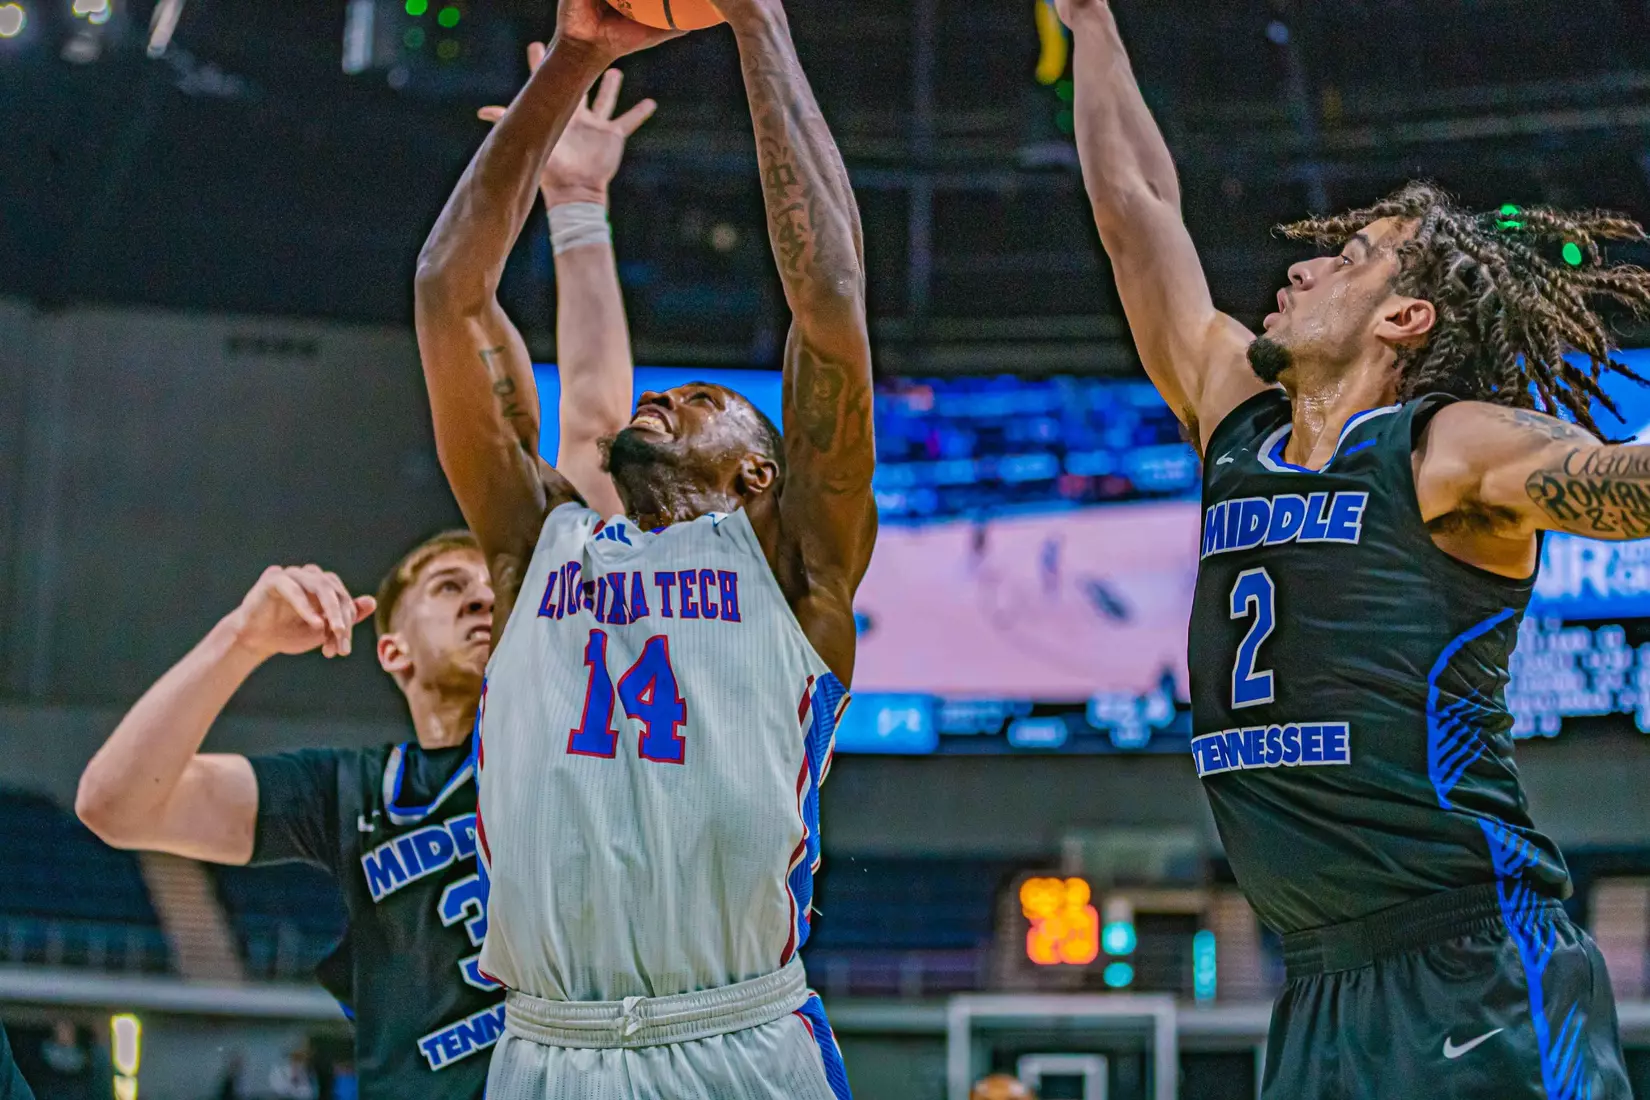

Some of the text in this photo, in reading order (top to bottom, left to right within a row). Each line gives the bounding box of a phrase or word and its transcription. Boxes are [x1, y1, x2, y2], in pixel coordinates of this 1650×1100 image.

[1200, 491, 1369, 560] MIDDLE
[654, 568, 742, 623] TECH
[1229, 566, 1276, 710] 2
[566, 628, 687, 766] 14
[1191, 721, 1351, 778] TENNESSEE
